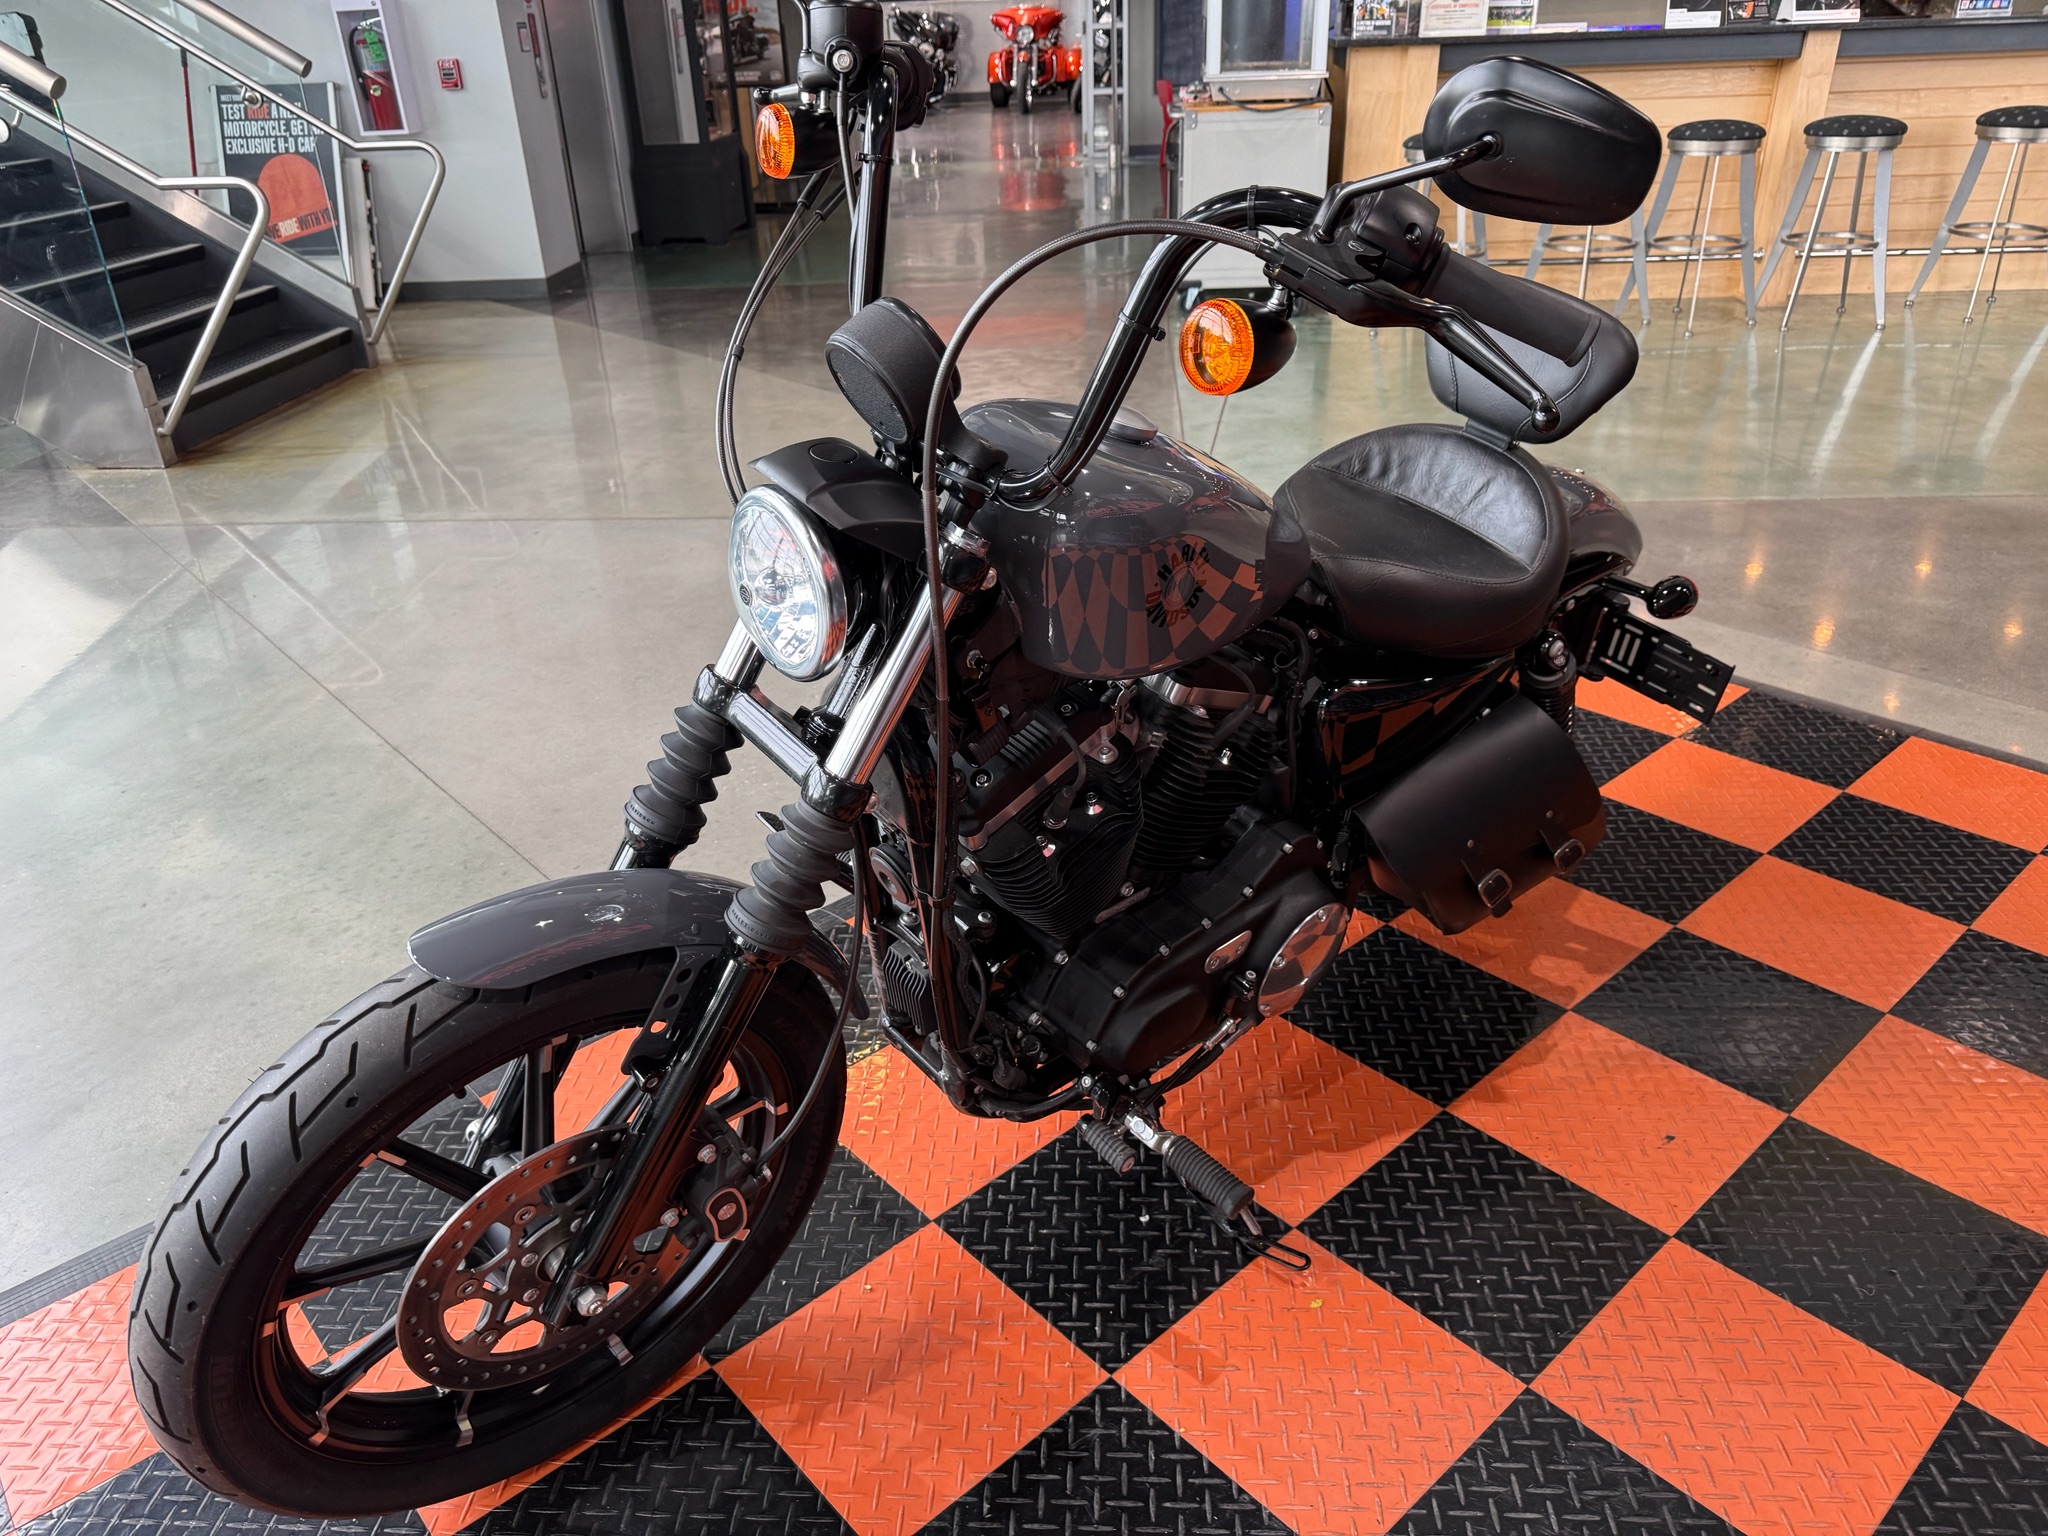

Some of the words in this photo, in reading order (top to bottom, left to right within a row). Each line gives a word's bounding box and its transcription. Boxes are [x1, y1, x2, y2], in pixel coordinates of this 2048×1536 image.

[221, 103, 245, 120] TEST
[247, 102, 271, 119] RIDE
[223, 120, 290, 138] MOTORCYCLE,
[290, 119, 308, 136] GET
[225, 137, 277, 154] EXCLUSIVE
[278, 137, 295, 153] H-D
[278, 217, 300, 237] RIDE
[298, 210, 321, 231] WITH
